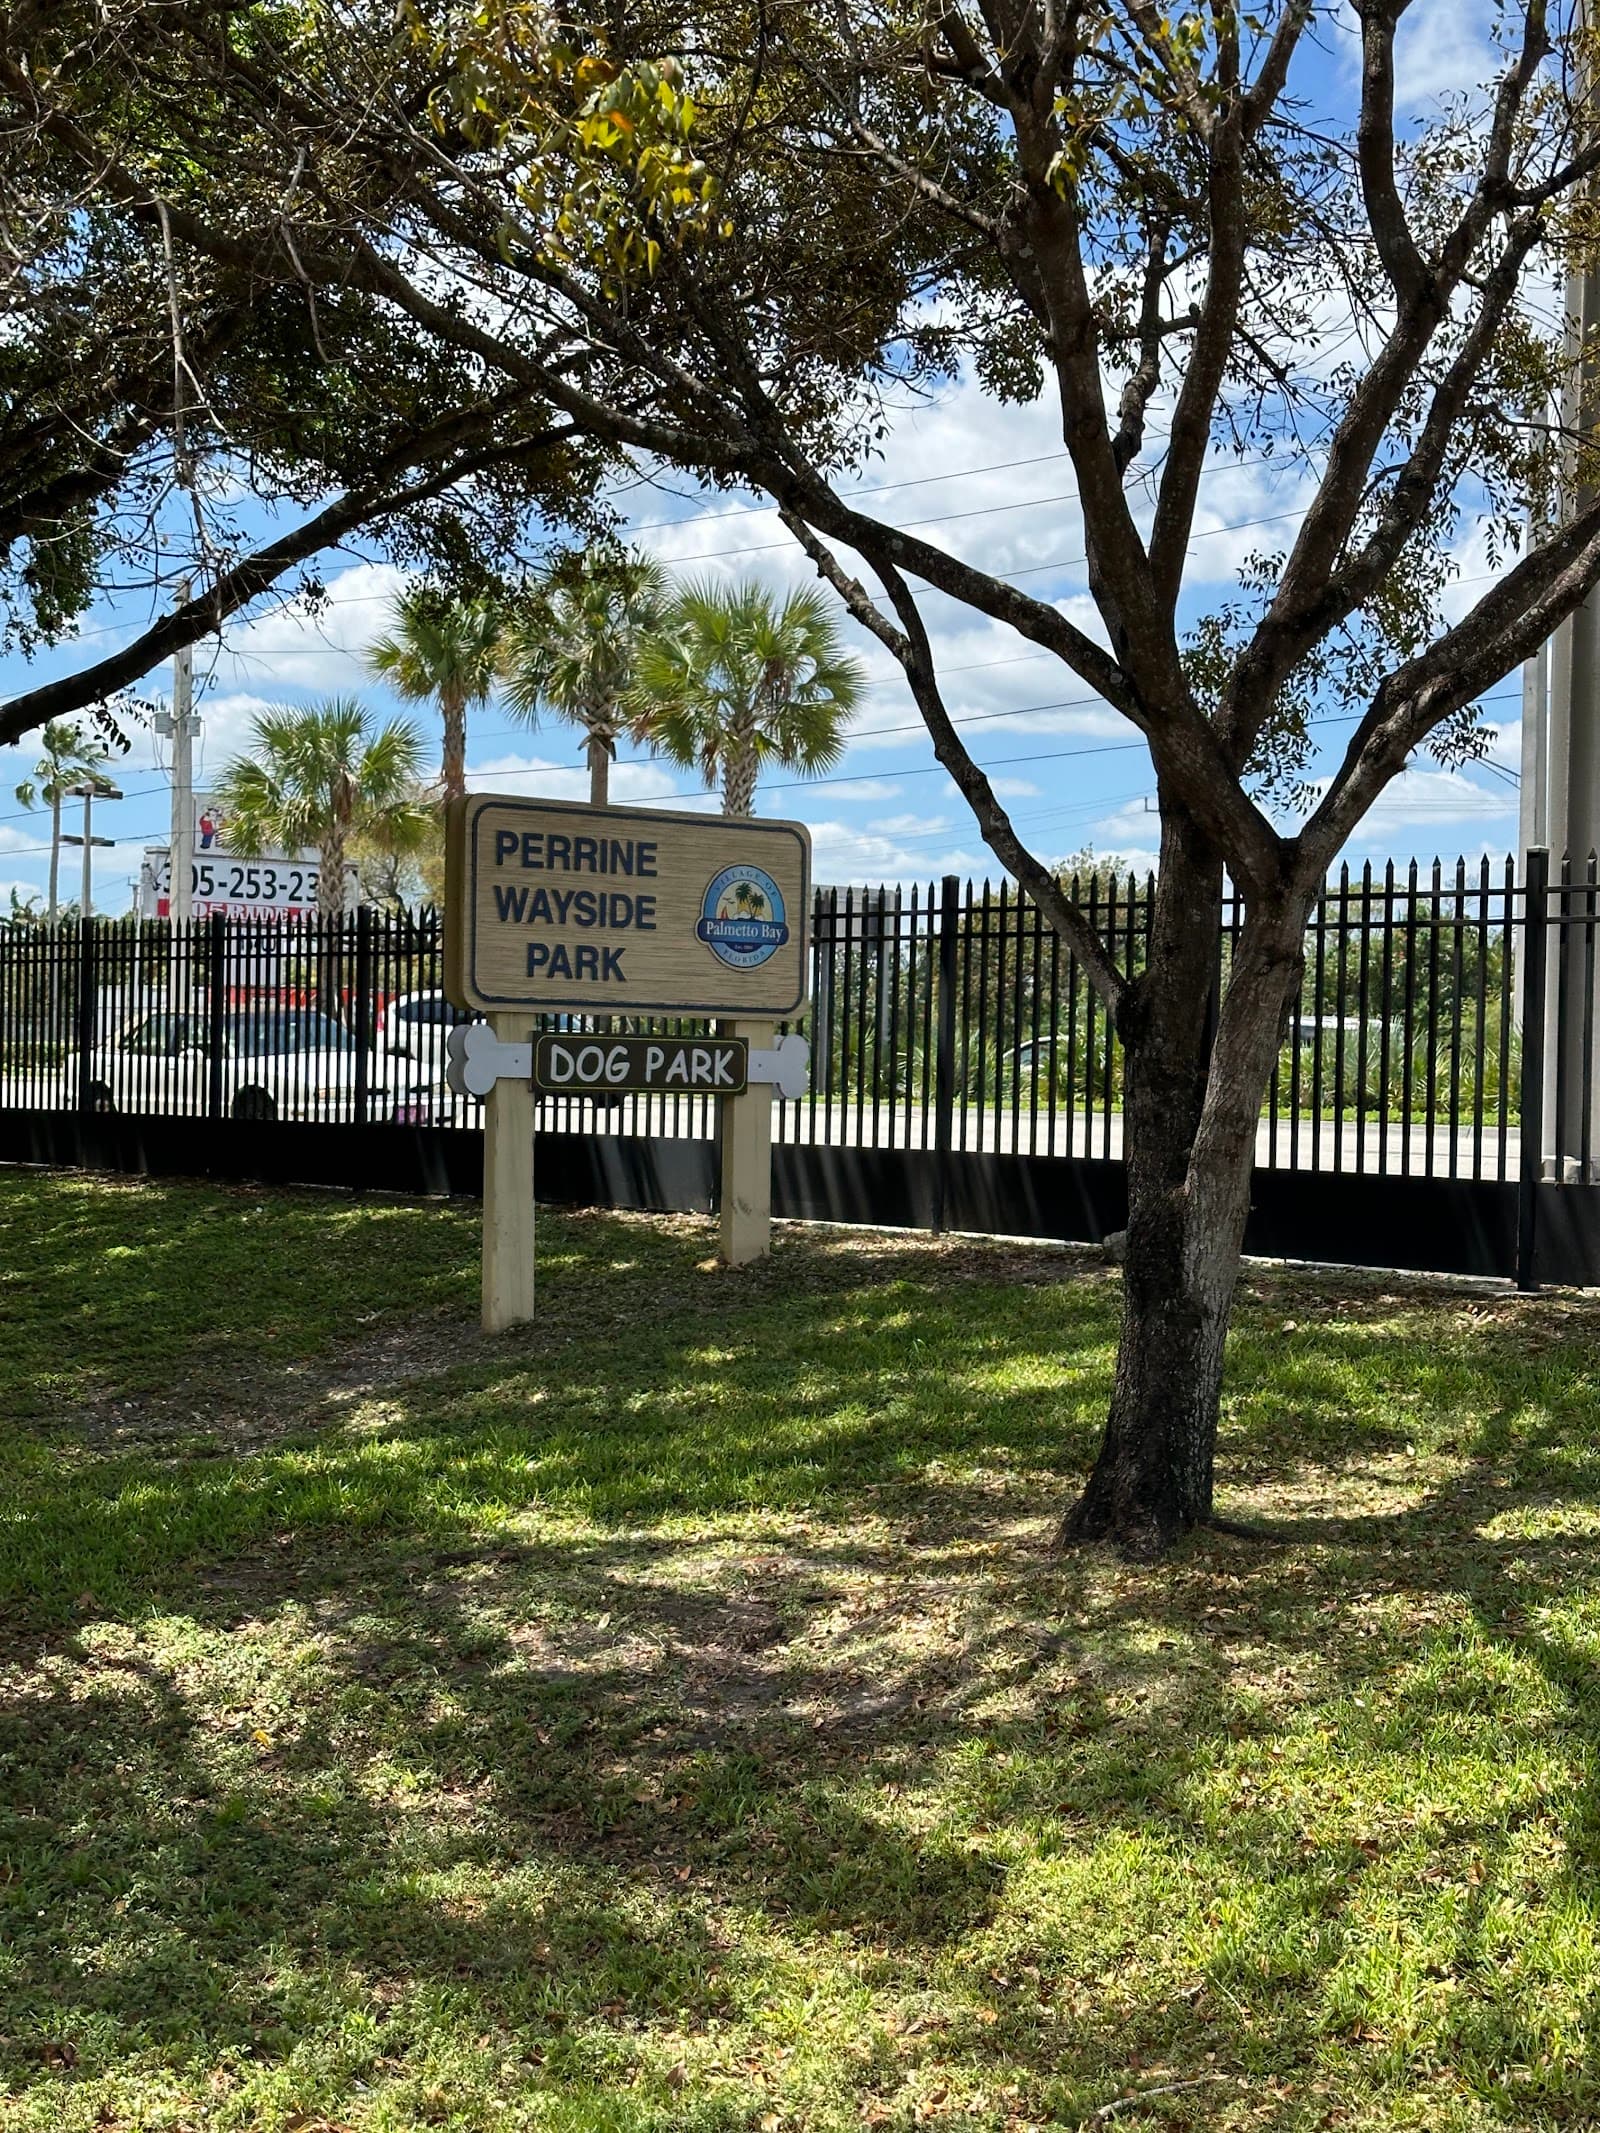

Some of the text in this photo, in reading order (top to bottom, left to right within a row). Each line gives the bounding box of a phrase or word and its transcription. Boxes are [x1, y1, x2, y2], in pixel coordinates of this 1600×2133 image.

[495, 830, 658, 877] PERRINE
[714, 870, 778, 897] VILLAGE OF
[493, 885, 657, 930] WAYSIDE
[706, 921, 784, 943] Palmetto Bay
[526, 943, 627, 982] PARK
[723, 949, 765, 964] FLORIDA
[550, 1044, 735, 1086] DOG PARK
